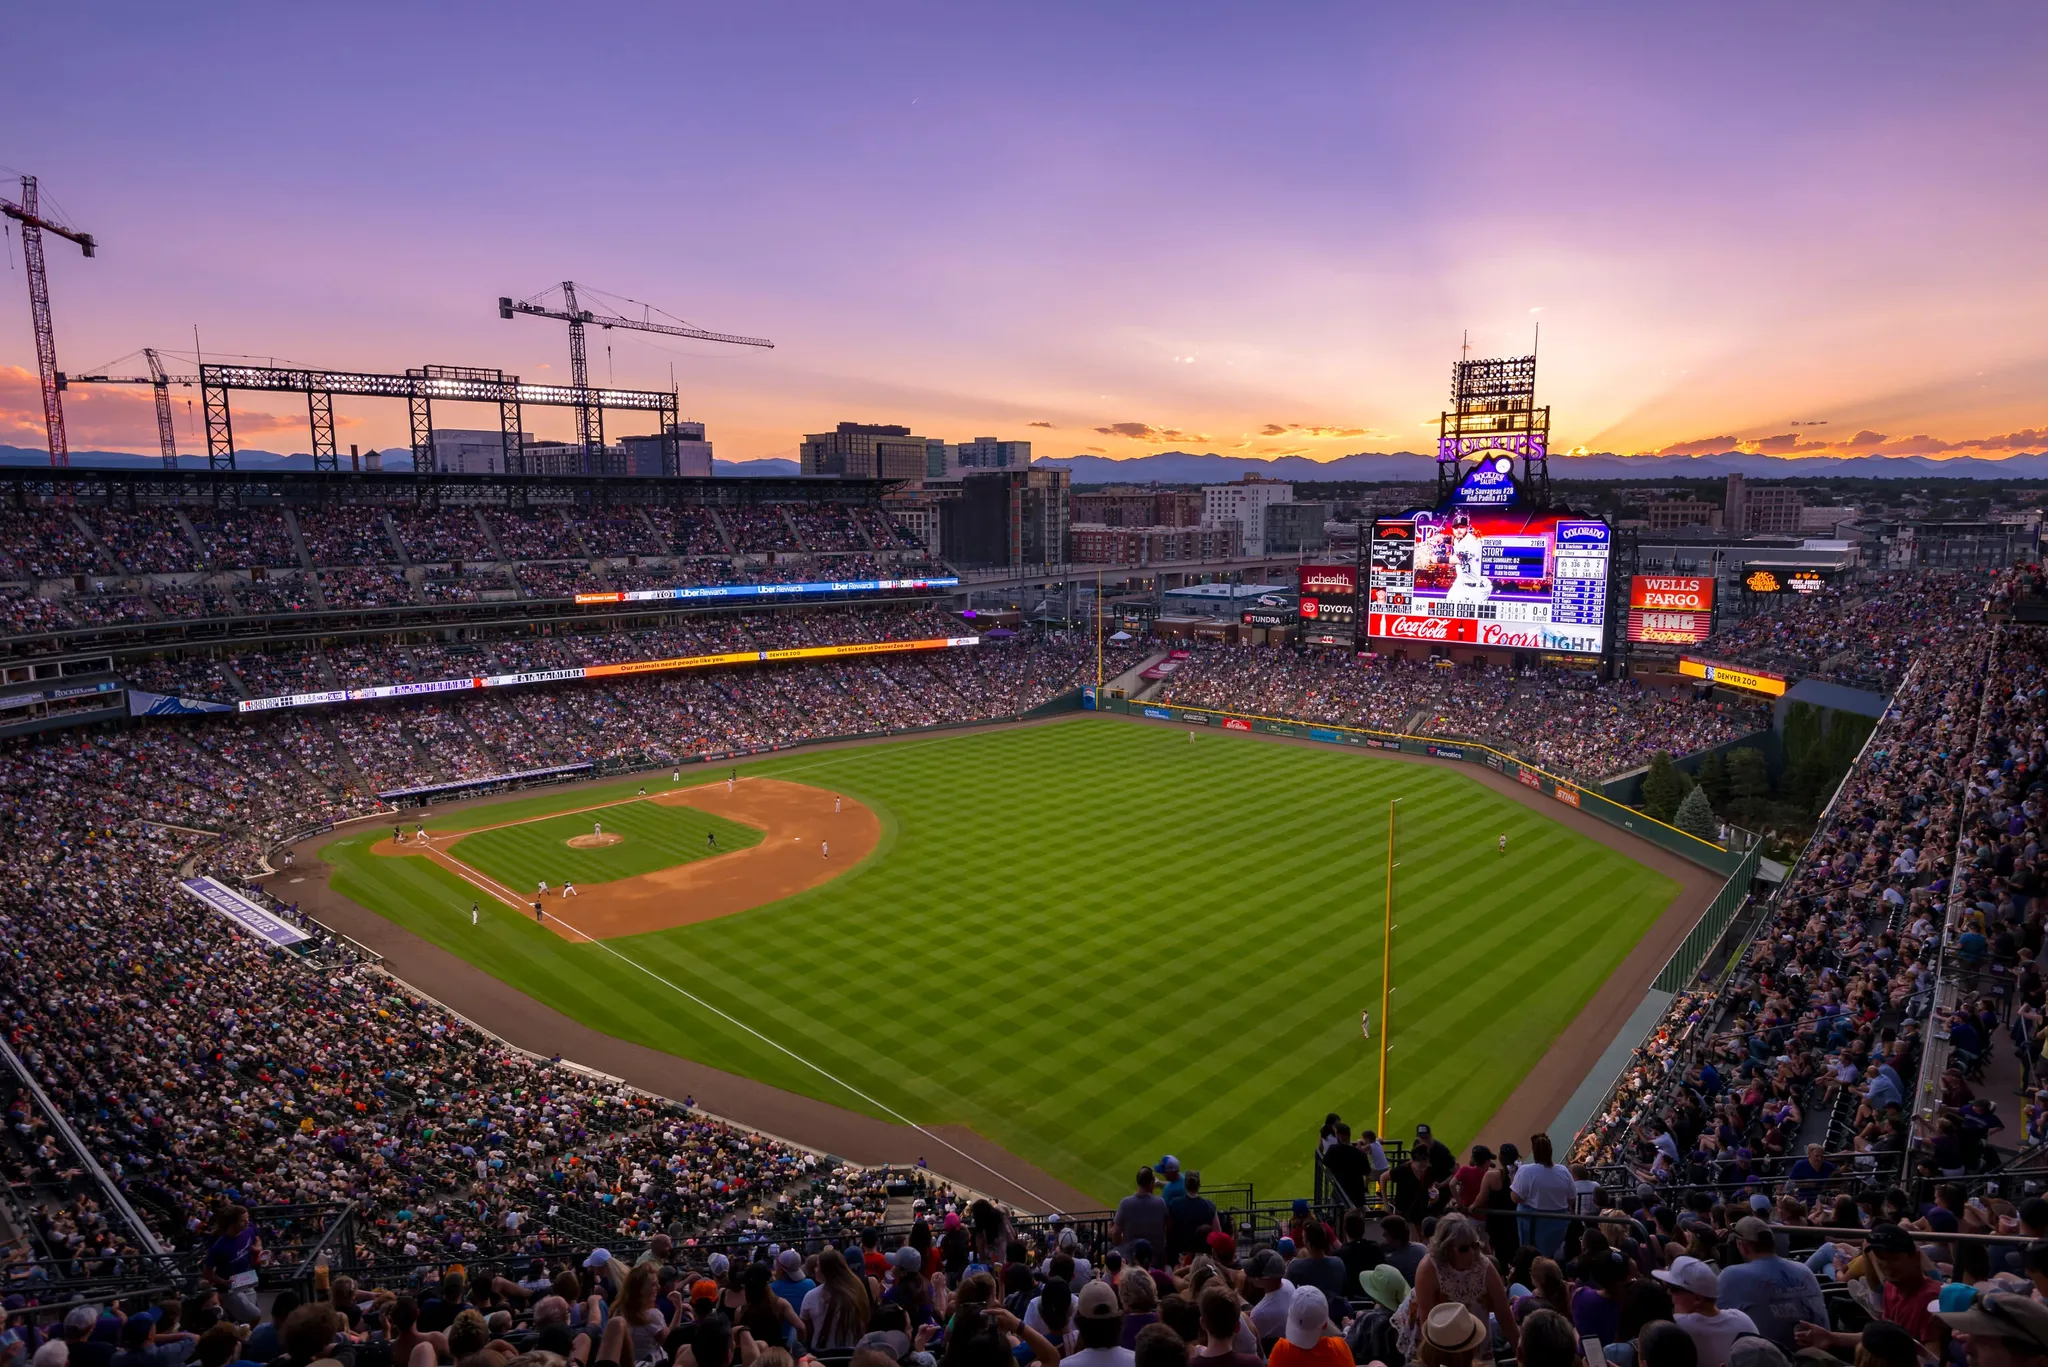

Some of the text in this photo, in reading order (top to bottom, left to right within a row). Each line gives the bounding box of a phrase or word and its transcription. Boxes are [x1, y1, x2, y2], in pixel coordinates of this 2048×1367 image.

[1563, 527, 1605, 539] COLORADO
[1482, 548, 1504, 556] STORY
[1307, 573, 1348, 585] uchealth
[1645, 579, 1699, 591] WELLS
[1644, 593, 1698, 605] FARGO
[1319, 605, 1353, 613] TOYOTA
[1252, 616, 1280, 624] TUNDRA
[1642, 613, 1694, 629] KING
[1483, 624, 1595, 651] Coors LIGHT
[1641, 627, 1696, 644] Soopers
[1717, 672, 1757, 686] DENVER ZOO
[55, 687, 97, 697] ROCKIES.com
[1437, 750, 1462, 758] Fanatics
[1557, 790, 1577, 804] STIHL
[202, 888, 279, 932] COLORADO ROCKIES
